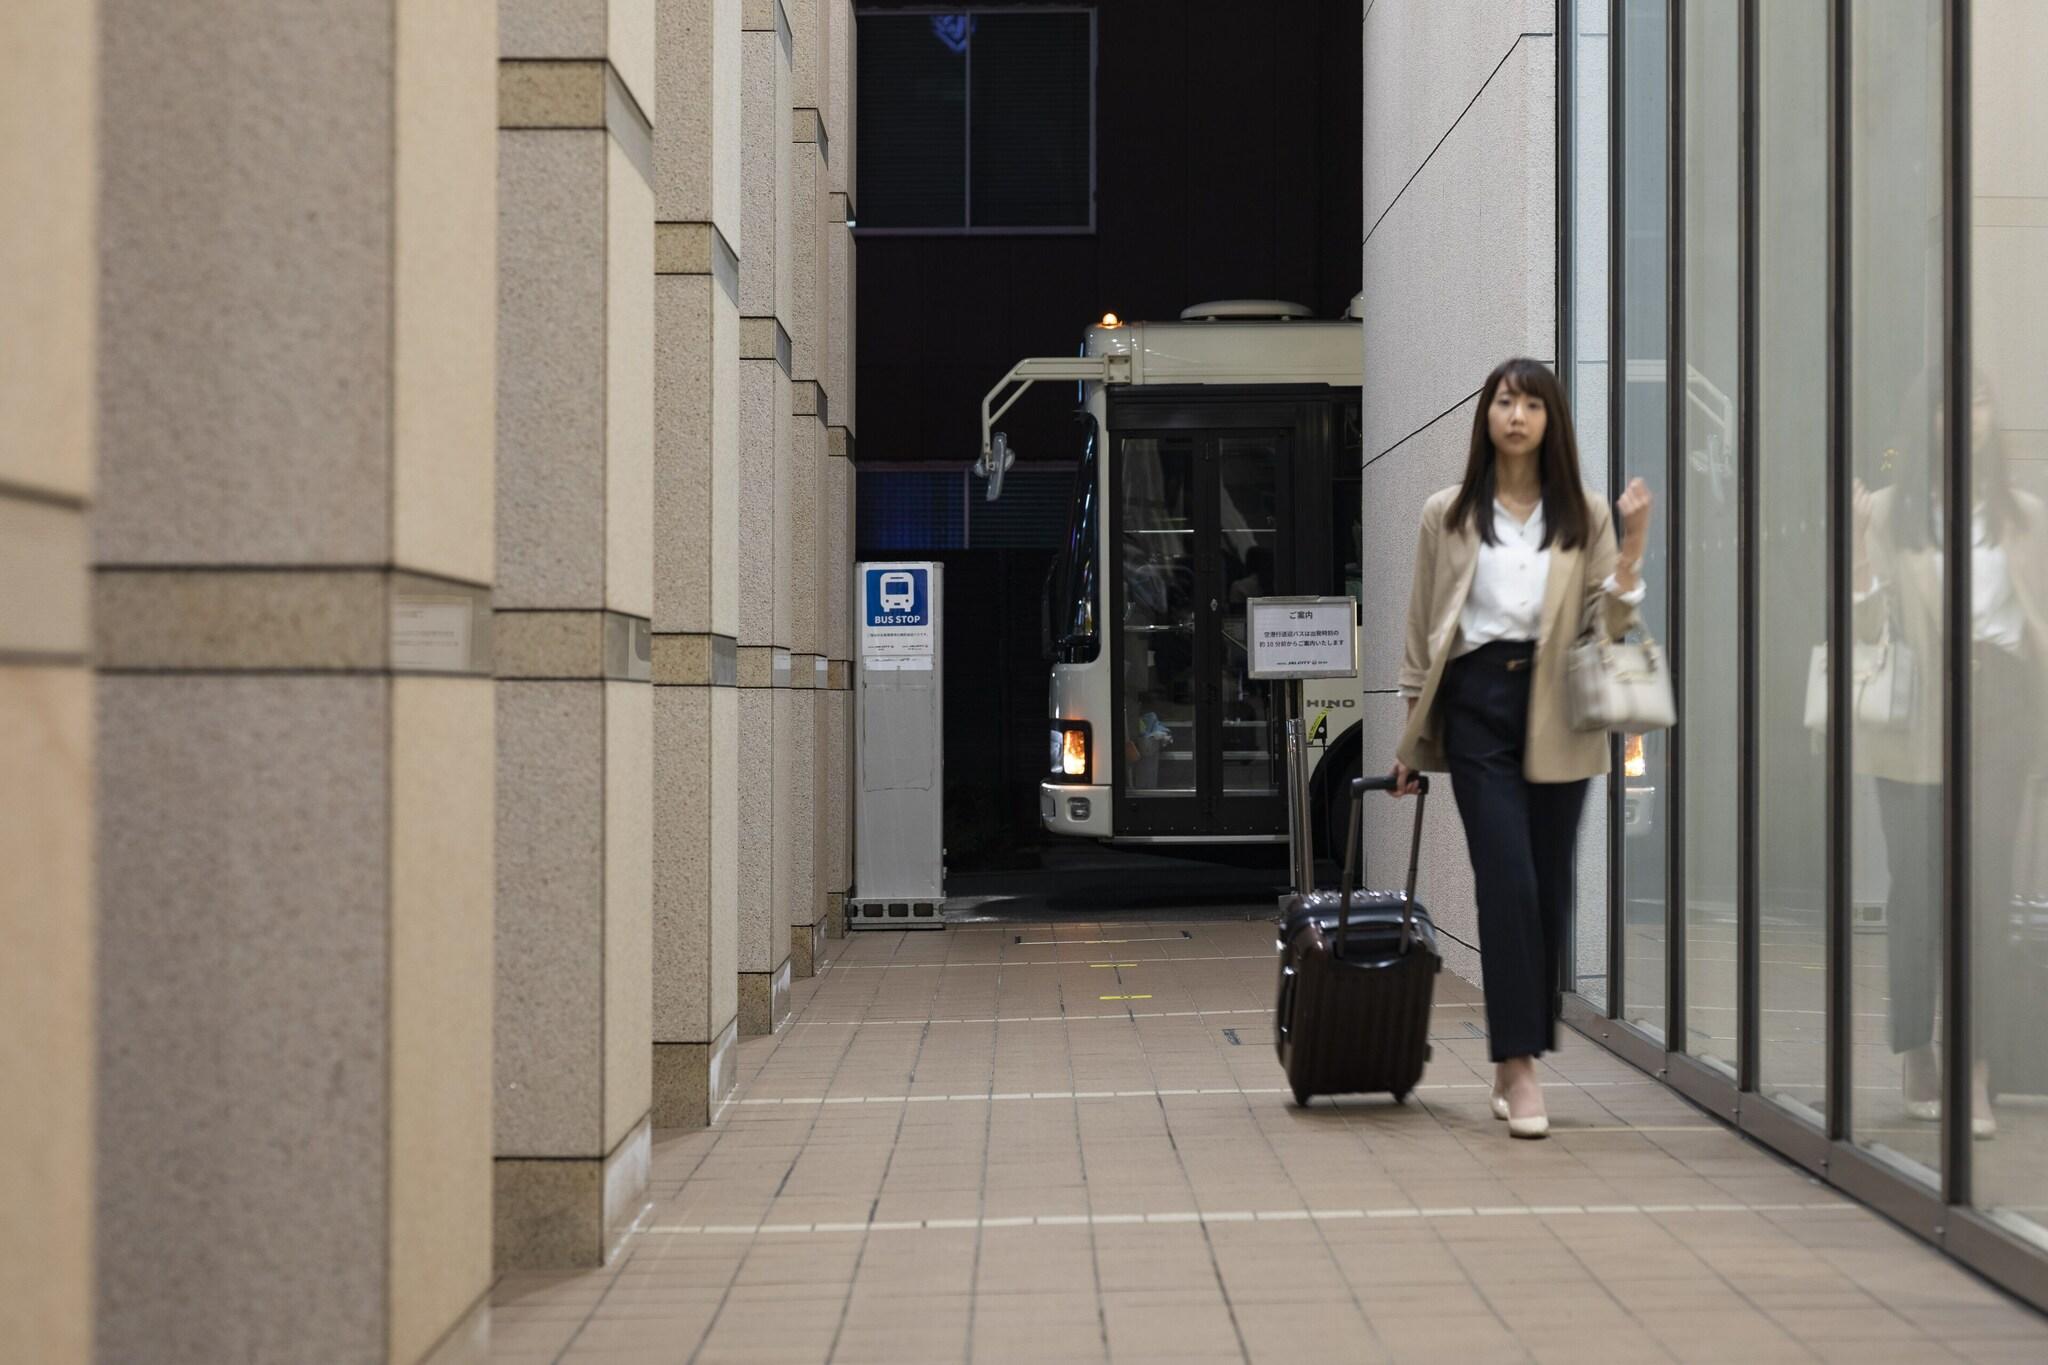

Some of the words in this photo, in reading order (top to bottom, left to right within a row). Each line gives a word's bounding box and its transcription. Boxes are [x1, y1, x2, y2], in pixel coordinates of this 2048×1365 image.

[874, 615, 894, 624] BUS
[895, 615, 921, 624] STOP
[1289, 611, 1313, 620] ご案内
[1306, 699, 1355, 708] HINO
